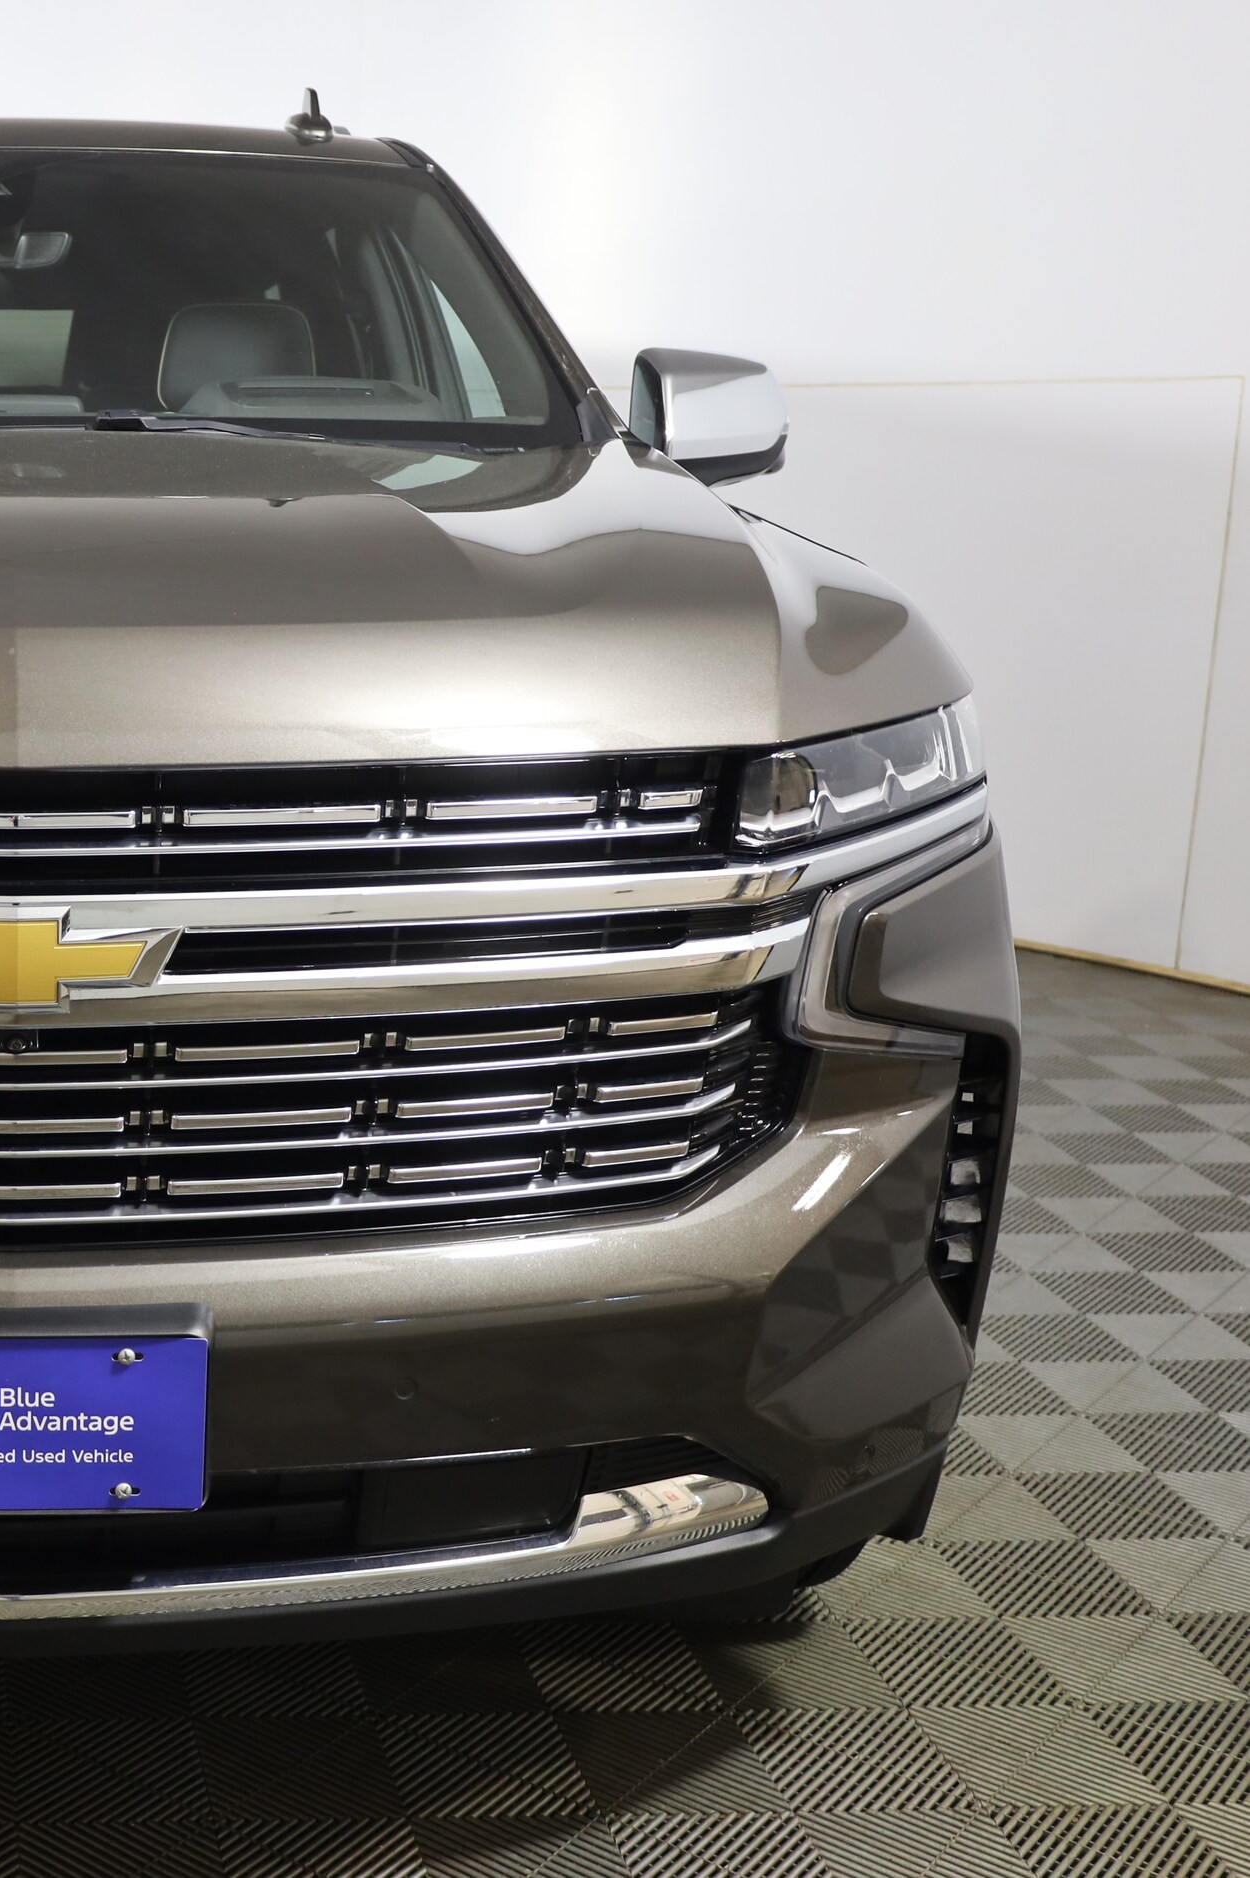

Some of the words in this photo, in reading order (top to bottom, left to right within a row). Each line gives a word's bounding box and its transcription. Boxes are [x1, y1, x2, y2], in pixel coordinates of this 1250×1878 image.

[0, 1387, 55, 1408] Blue
[0, 1411, 135, 1435] Advantage
[22, 1449, 66, 1464] Used
[72, 1449, 134, 1464] Vehicle
